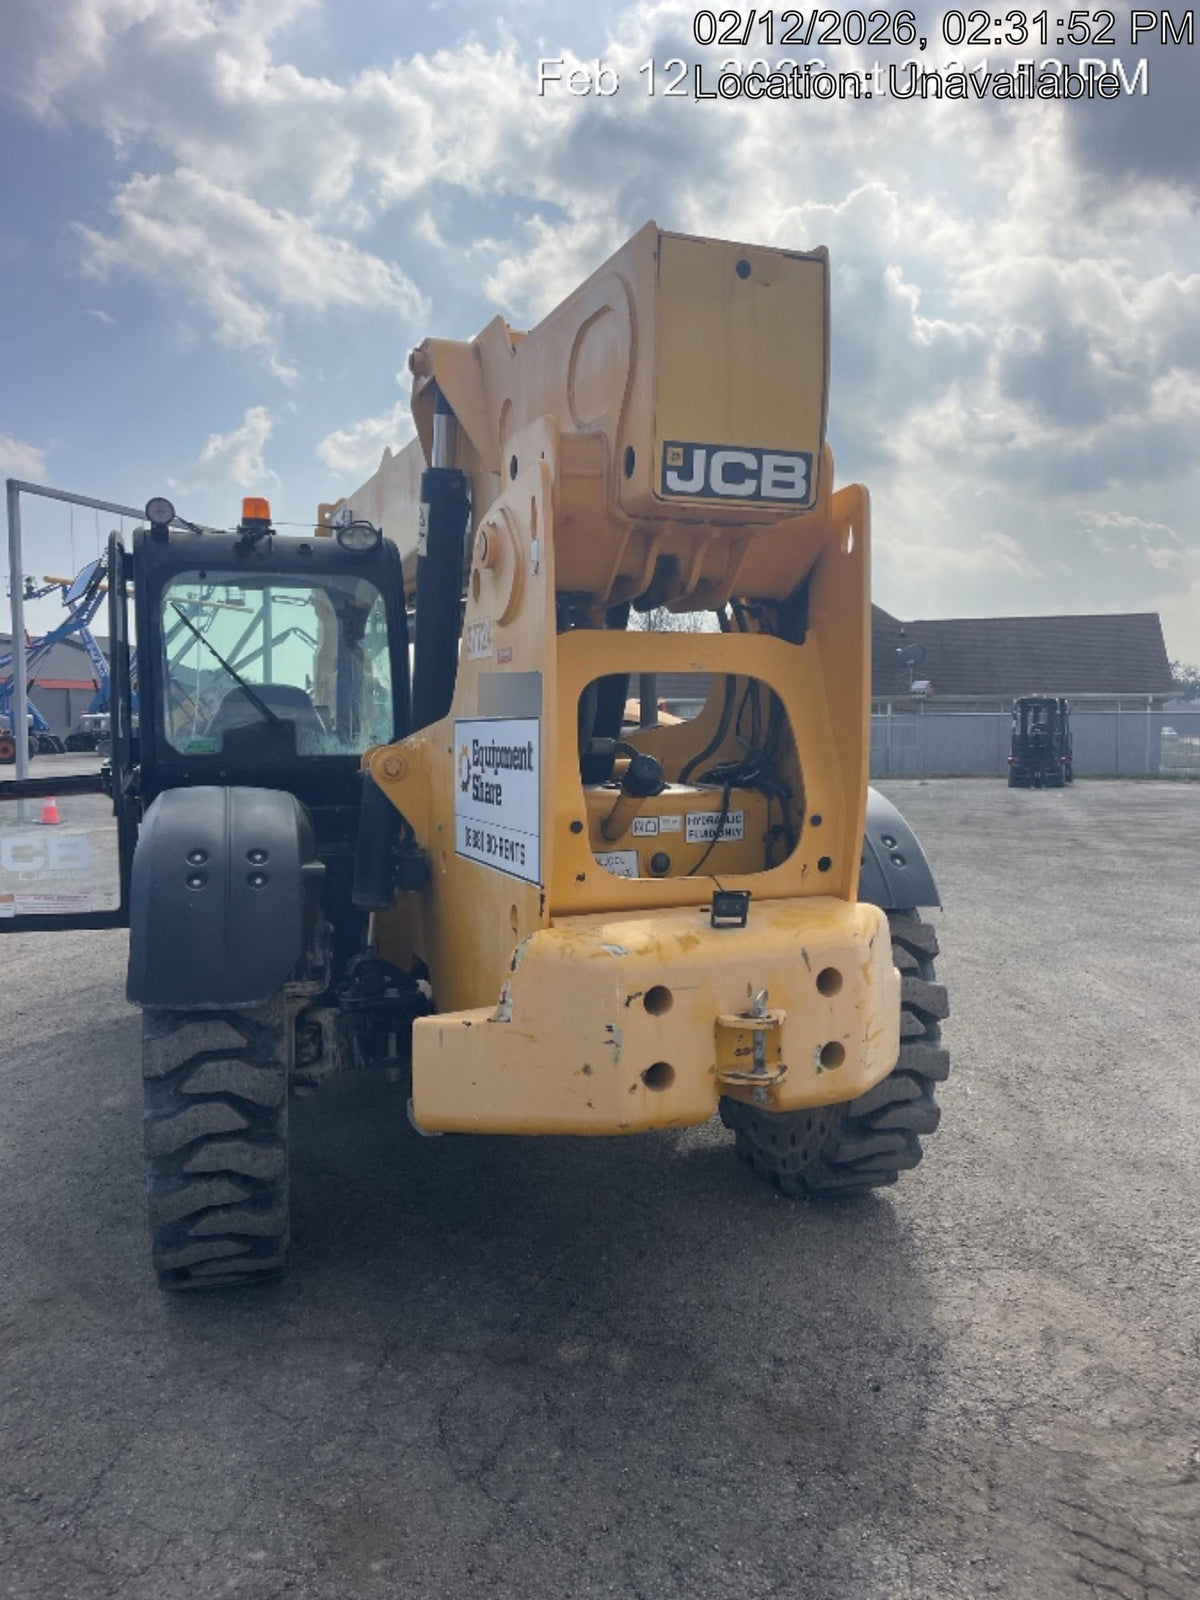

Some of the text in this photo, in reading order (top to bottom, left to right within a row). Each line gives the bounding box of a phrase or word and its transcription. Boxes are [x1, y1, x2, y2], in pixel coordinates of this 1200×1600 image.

[666, 449, 807, 498] JCB
[472, 738, 533, 776] Equipment
[472, 774, 502, 806] Share
